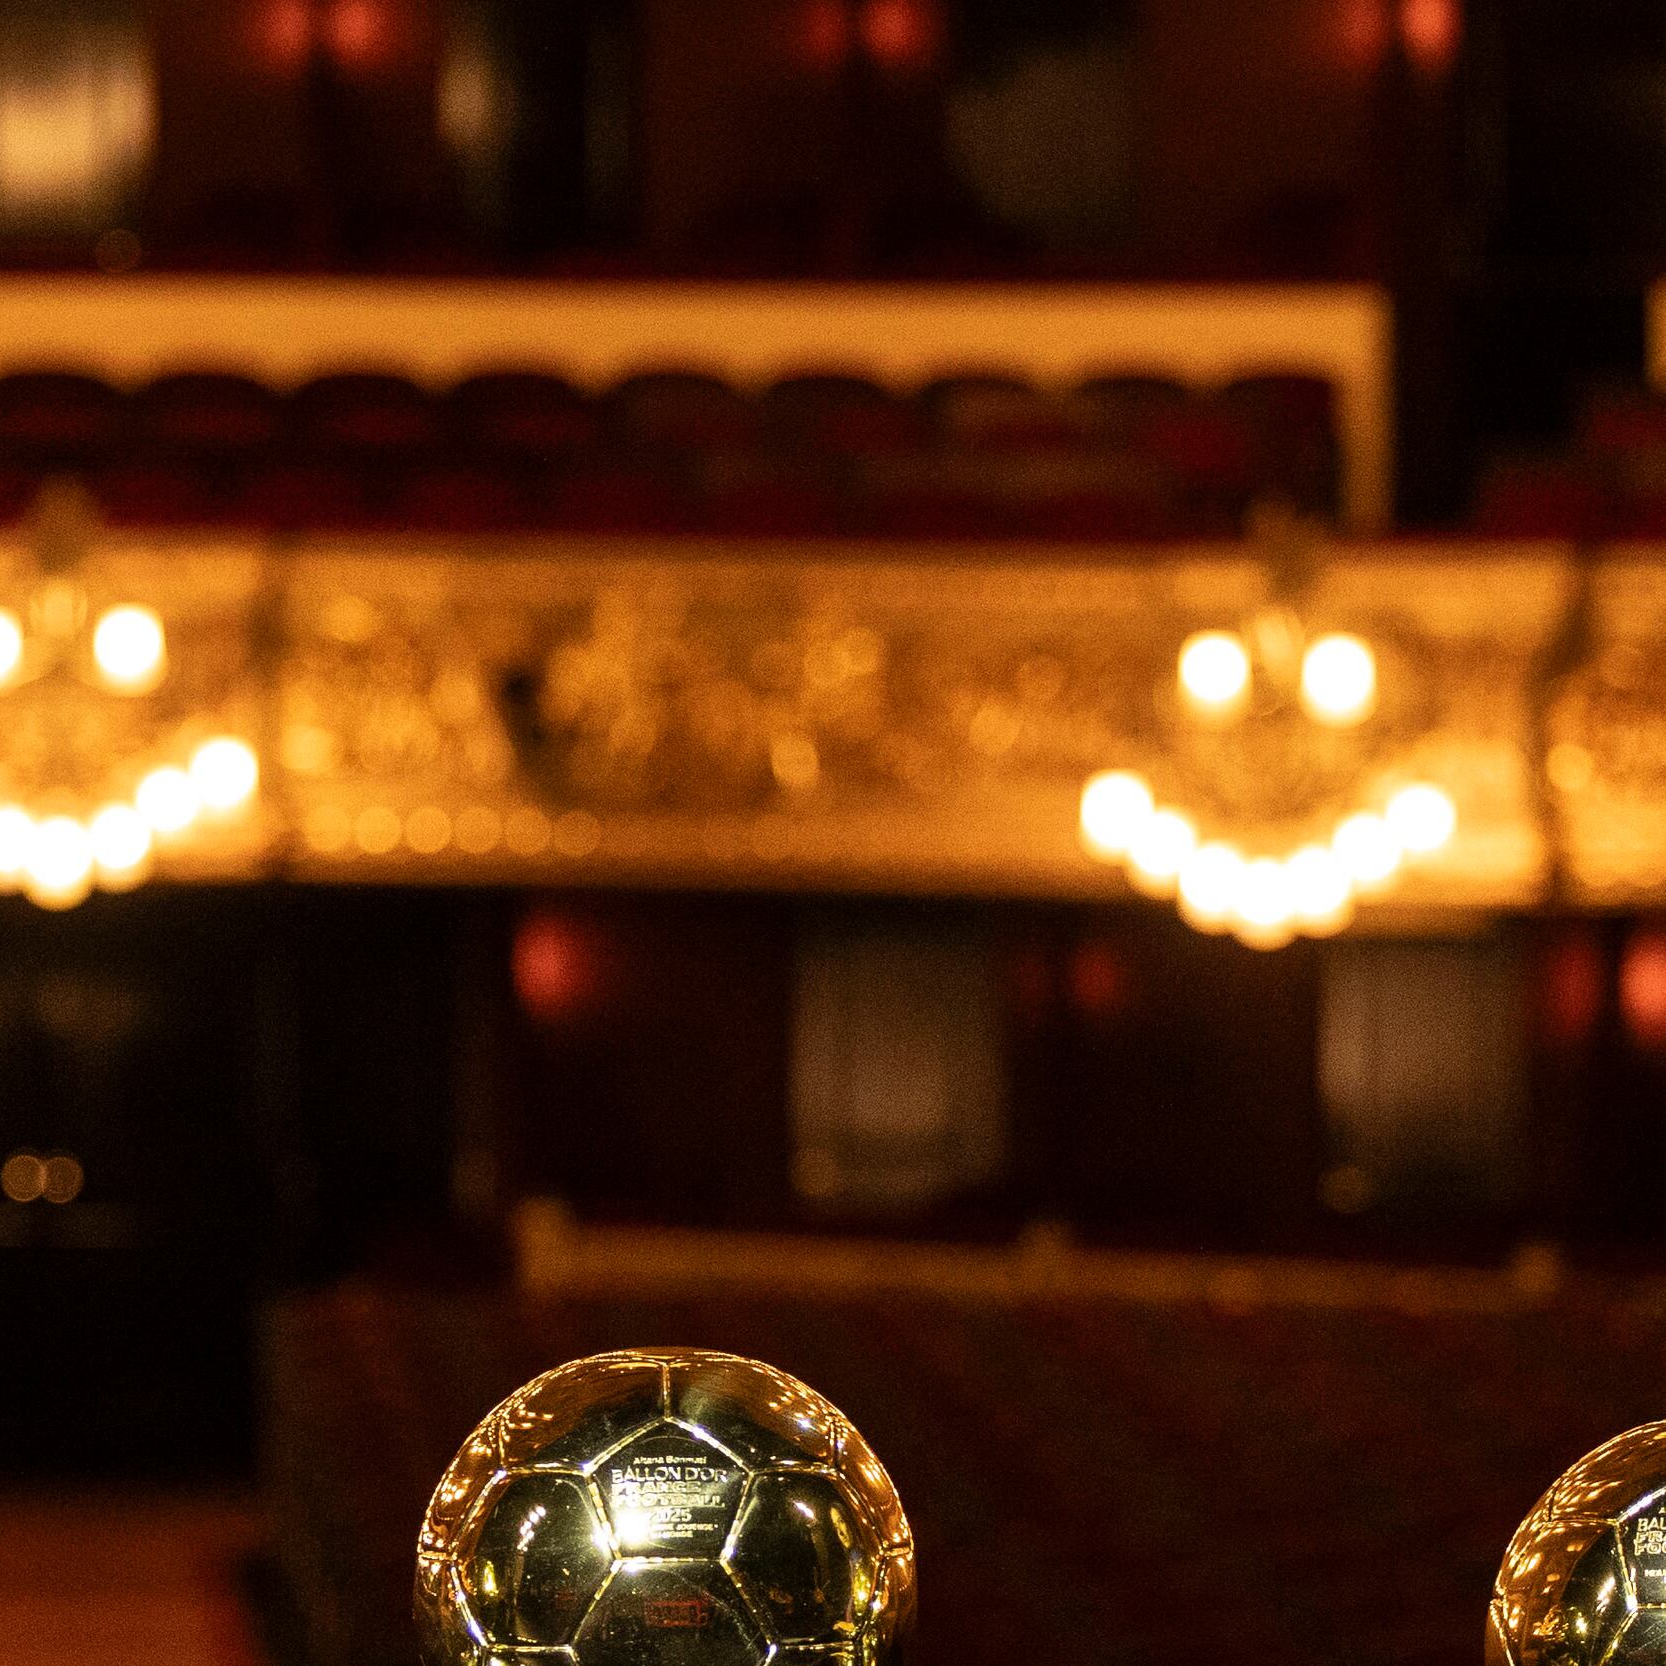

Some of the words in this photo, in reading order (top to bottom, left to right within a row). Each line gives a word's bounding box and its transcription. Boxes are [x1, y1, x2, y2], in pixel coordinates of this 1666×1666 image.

[611, 1465, 682, 1484] BALLON
[685, 1466, 729, 1483] D'OR
[650, 1508, 693, 1522] 2025
